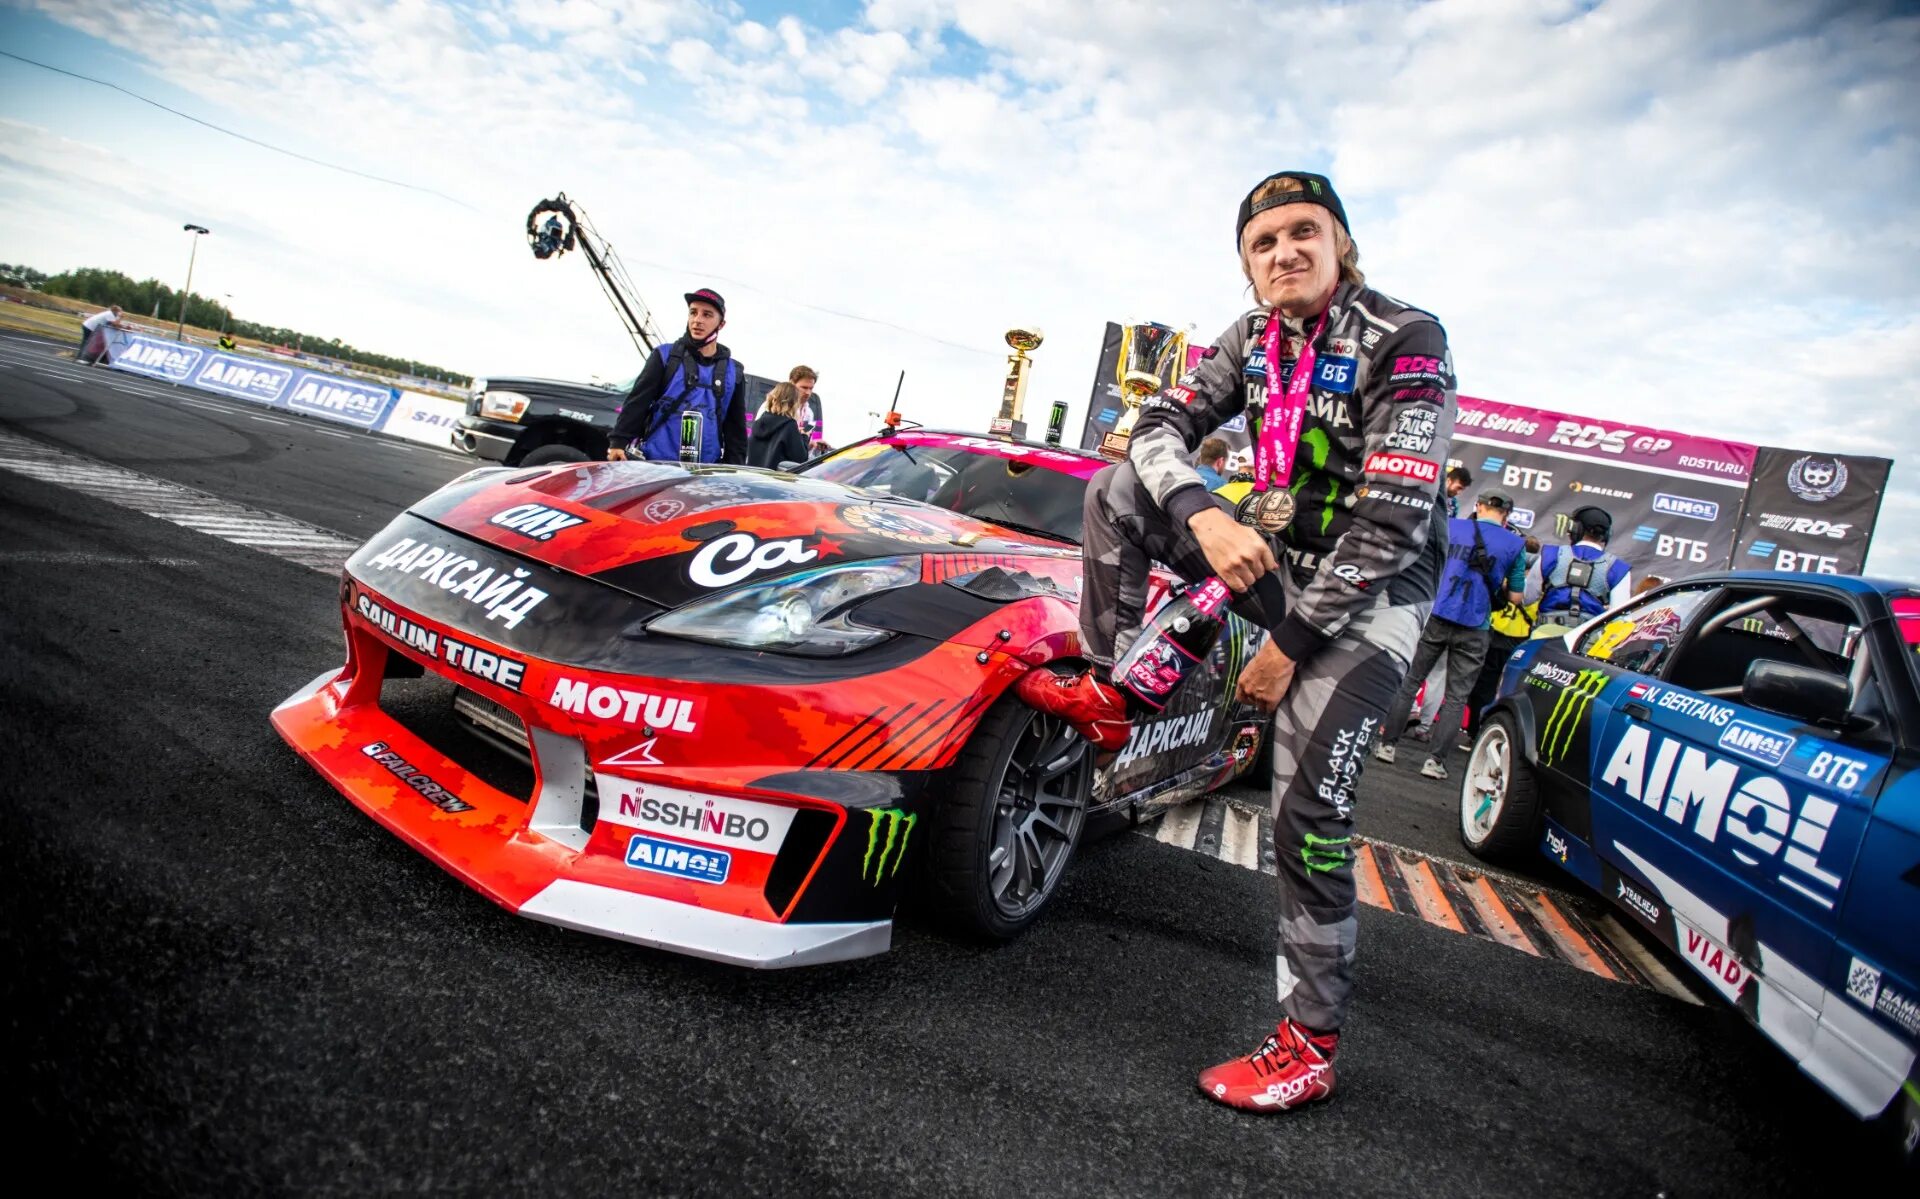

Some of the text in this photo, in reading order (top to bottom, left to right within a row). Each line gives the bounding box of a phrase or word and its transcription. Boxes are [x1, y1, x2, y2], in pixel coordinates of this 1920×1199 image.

[120, 338, 198, 377] AIMOL
[202, 358, 283, 398] AIMOL
[1390, 373, 1421, 382] RUSSIAN
[293, 380, 379, 420] AIMOL
[1384, 432, 1433, 454] CREW
[1483, 413, 1540, 437] Series
[1548, 419, 1636, 454] RDS
[1632, 436, 1673, 456] GP
[1678, 455, 1746, 475] RDSTV.RU
[1368, 456, 1437, 481] MOTUL
[1502, 464, 1553, 493] ВТБ
[1367, 490, 1433, 511] SAILUN
[1655, 497, 1715, 517] AIMOL
[1788, 517, 1854, 539] RDS
[1655, 534, 1709, 563] ВТБ
[366, 538, 550, 631] ДАРКСАЙД
[357, 595, 525, 691] SAILUN TIRE
[549, 677, 698, 734] MOTUL
[1641, 687, 1734, 727] N. BERTANS
[1114, 701, 1215, 773] ДАРКСАЙД
[1723, 724, 1786, 760] AIMOL
[1318, 728, 1355, 801] BLACK
[1806, 751, 1868, 791] ВТБ
[619, 786, 770, 842] NISSHINBO
[1602, 724, 1842, 910] AIMOL
[629, 842, 724, 878] AIMOL
[1546, 827, 1568, 856] hgk
[1625, 886, 1660, 918] TRAILHEAD
